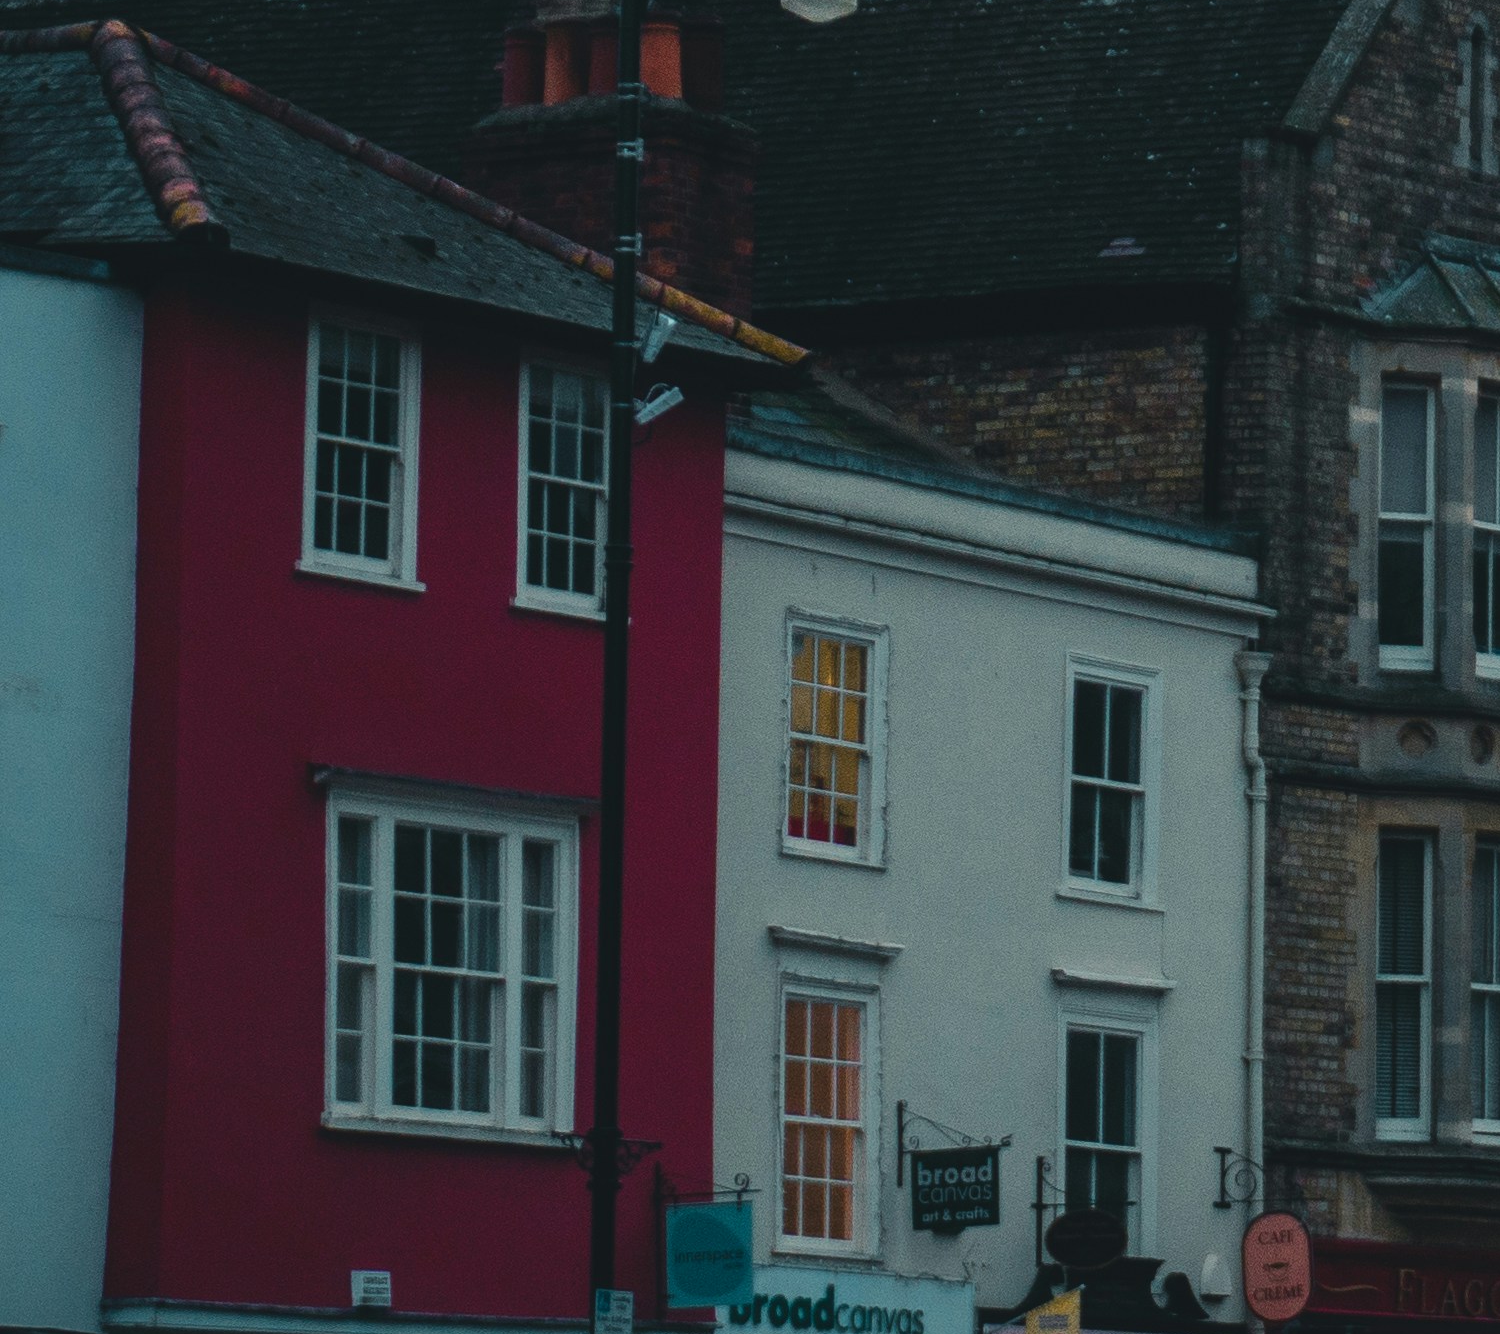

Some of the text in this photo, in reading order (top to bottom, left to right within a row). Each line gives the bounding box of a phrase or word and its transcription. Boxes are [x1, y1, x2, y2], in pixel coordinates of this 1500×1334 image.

[918, 1156, 993, 1186] broad
[918, 1184, 992, 1205] canvas
[922, 1206, 990, 1223] art & crafts
